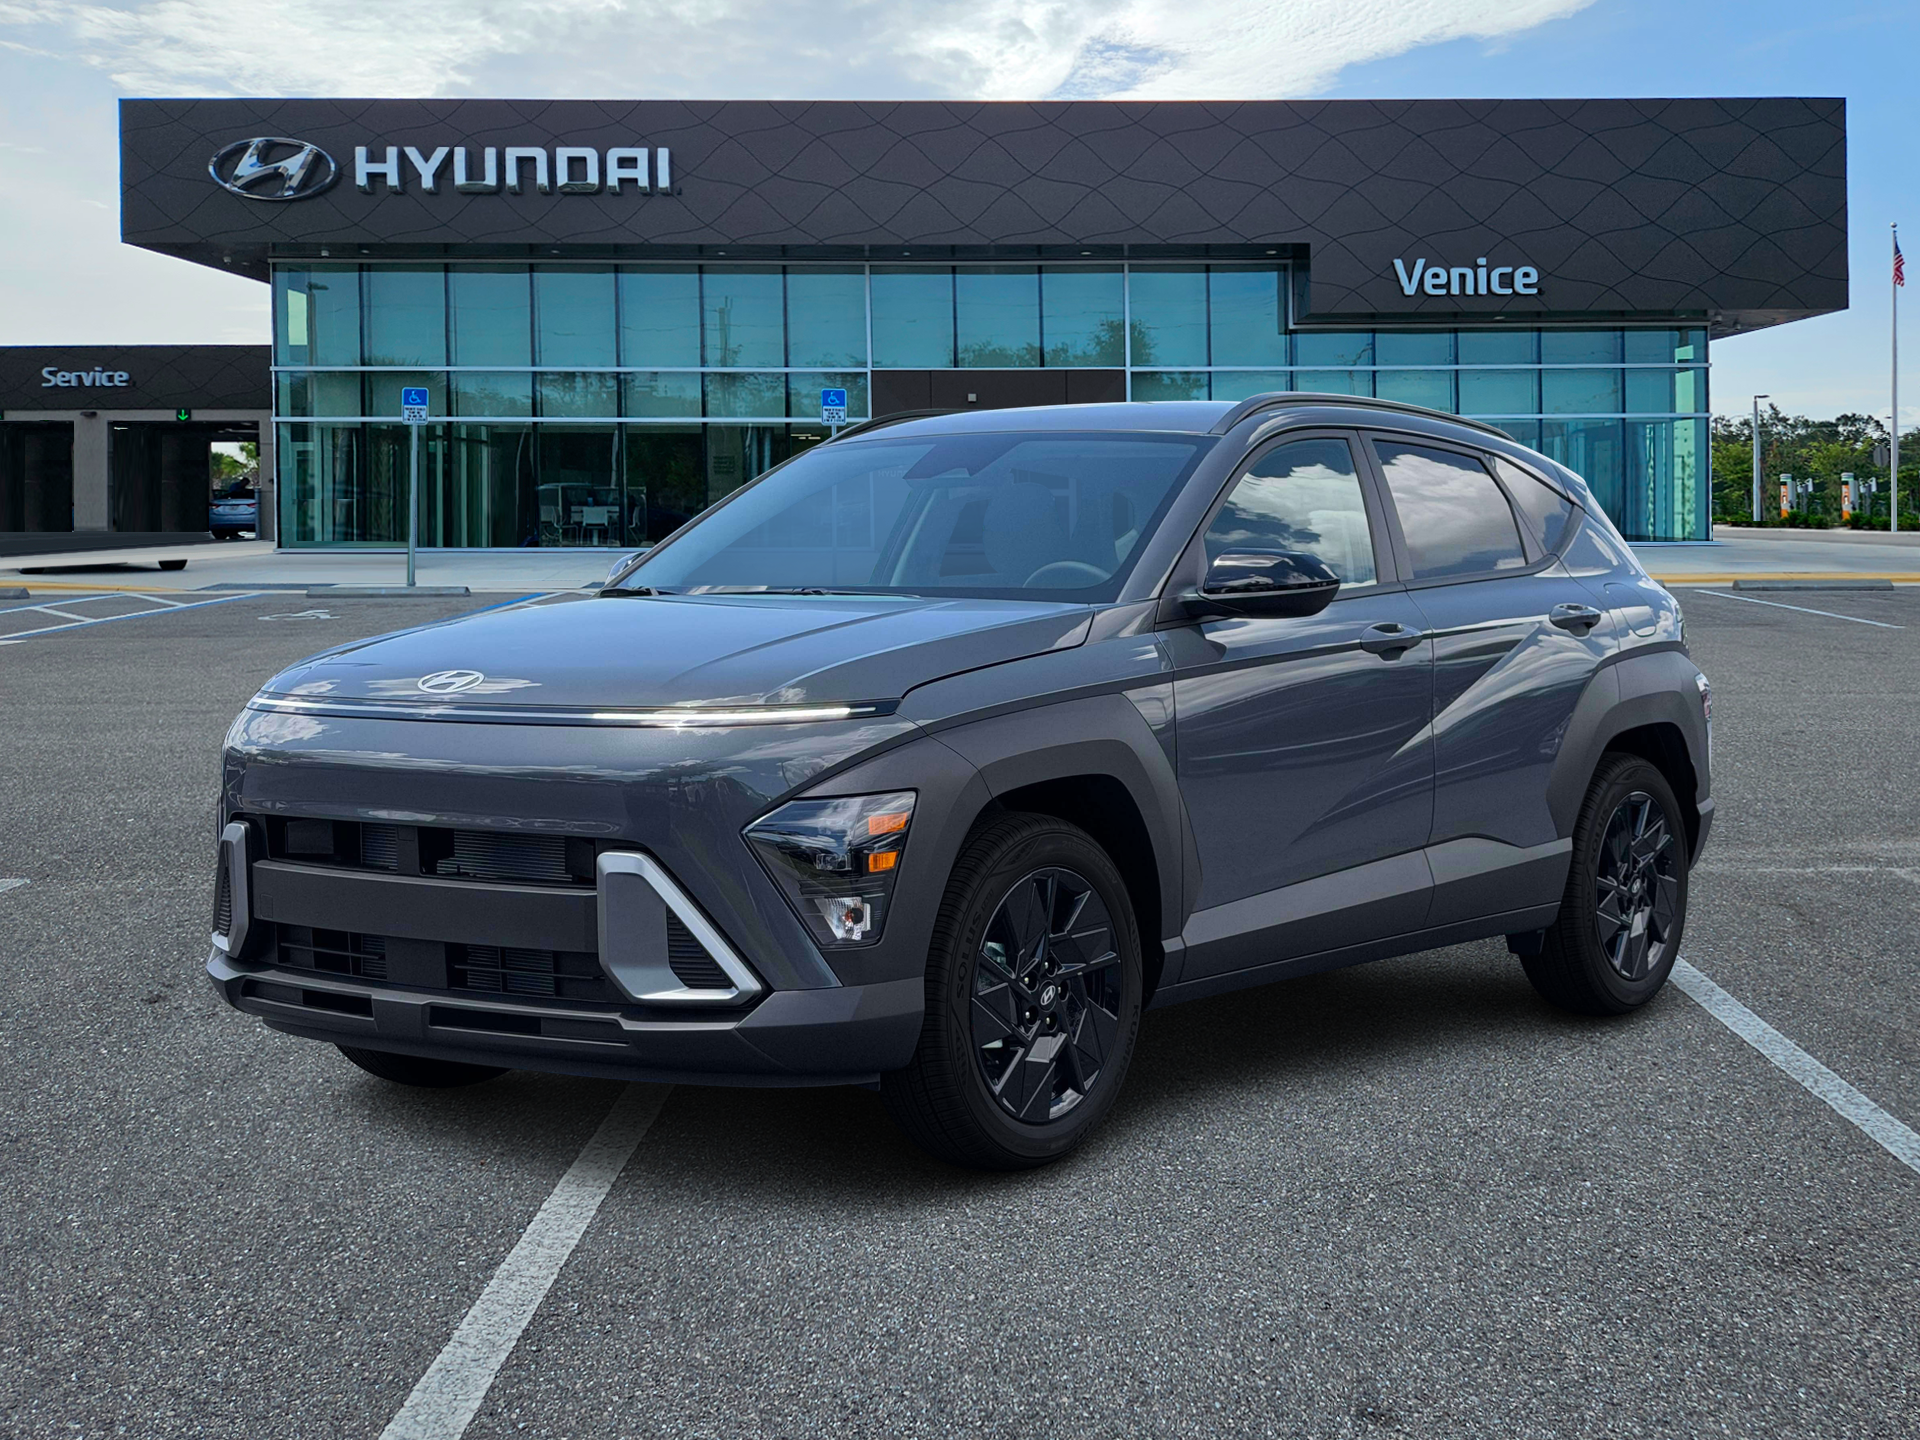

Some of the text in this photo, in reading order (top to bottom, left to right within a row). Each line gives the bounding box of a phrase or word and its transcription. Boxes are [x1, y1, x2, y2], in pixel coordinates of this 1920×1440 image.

[355, 146, 671, 194] HYUNDAI
[1393, 257, 1539, 296] Venice
[41, 366, 129, 387] Service
[956, 911, 982, 999] SOLUS
[1115, 1004, 1139, 1085] KUMHO
